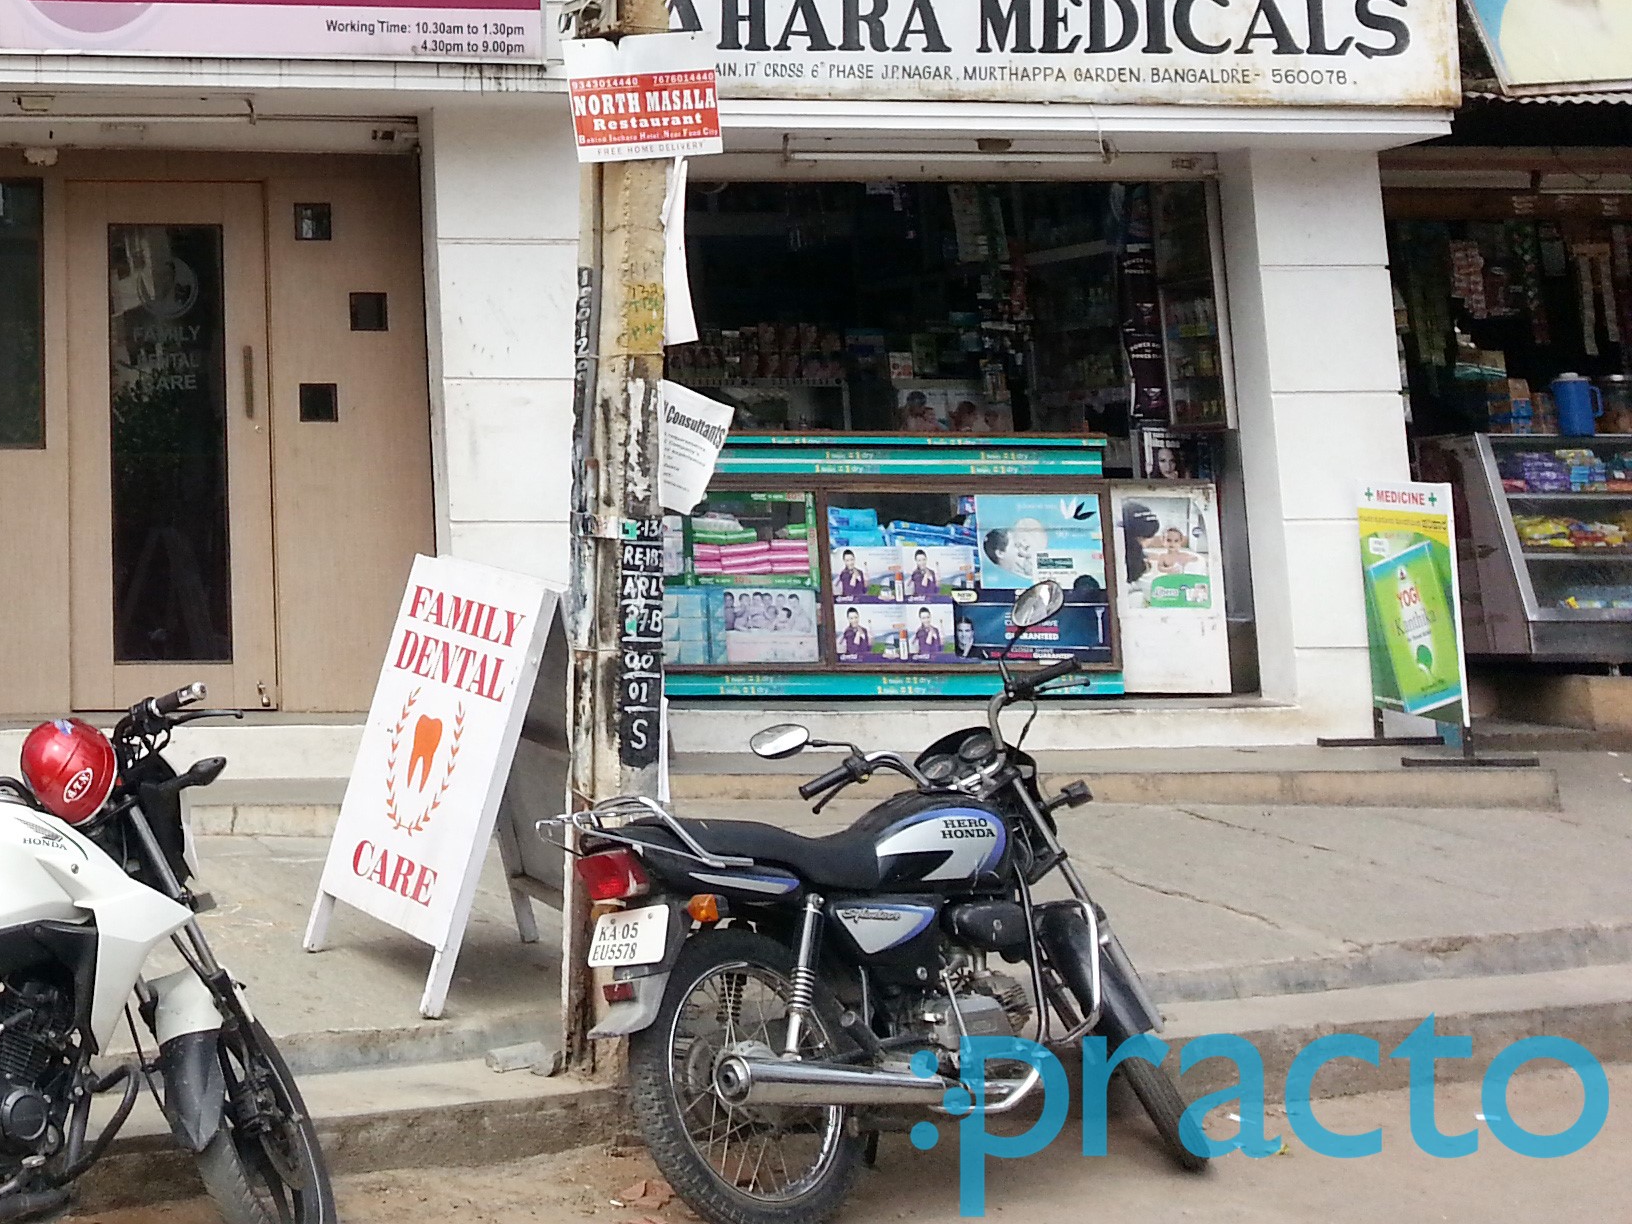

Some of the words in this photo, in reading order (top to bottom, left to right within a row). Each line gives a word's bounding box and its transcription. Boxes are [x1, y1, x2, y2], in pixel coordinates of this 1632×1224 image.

[325, 19, 376, 36] Working
[377, 19, 411, 34] Time:
[415, 22, 464, 35] 10.30am
[467, 23, 479, 35] to
[482, 23, 525, 38] 1.30pm
[420, 40, 464, 55] 4.30pm
[467, 40, 479, 53] to
[481, 40, 525, 56] 9.00pm
[828, 63, 874, 79] PHASE
[963, 65, 1067, 83] MURTHAPPA
[573, 91, 641, 117] NORTH
[645, 87, 716, 113] MASALA
[593, 112, 704, 131] Restaurant
[597, 146, 622, 156] FREE
[627, 144, 655, 154] HOME
[658, 140, 705, 152] DELIVERY
[666, 404, 727, 450] Consultants
[1375, 489, 1426, 506] MEDICINE
[406, 584, 527, 649] FAMILY
[393, 629, 506, 704] DENTAL
[629, 718, 649, 750] S
[942, 817, 989, 829] HERO
[940, 828, 997, 840] HONDA
[22, 837, 68, 851] HONDA
[352, 839, 439, 908] CARE
